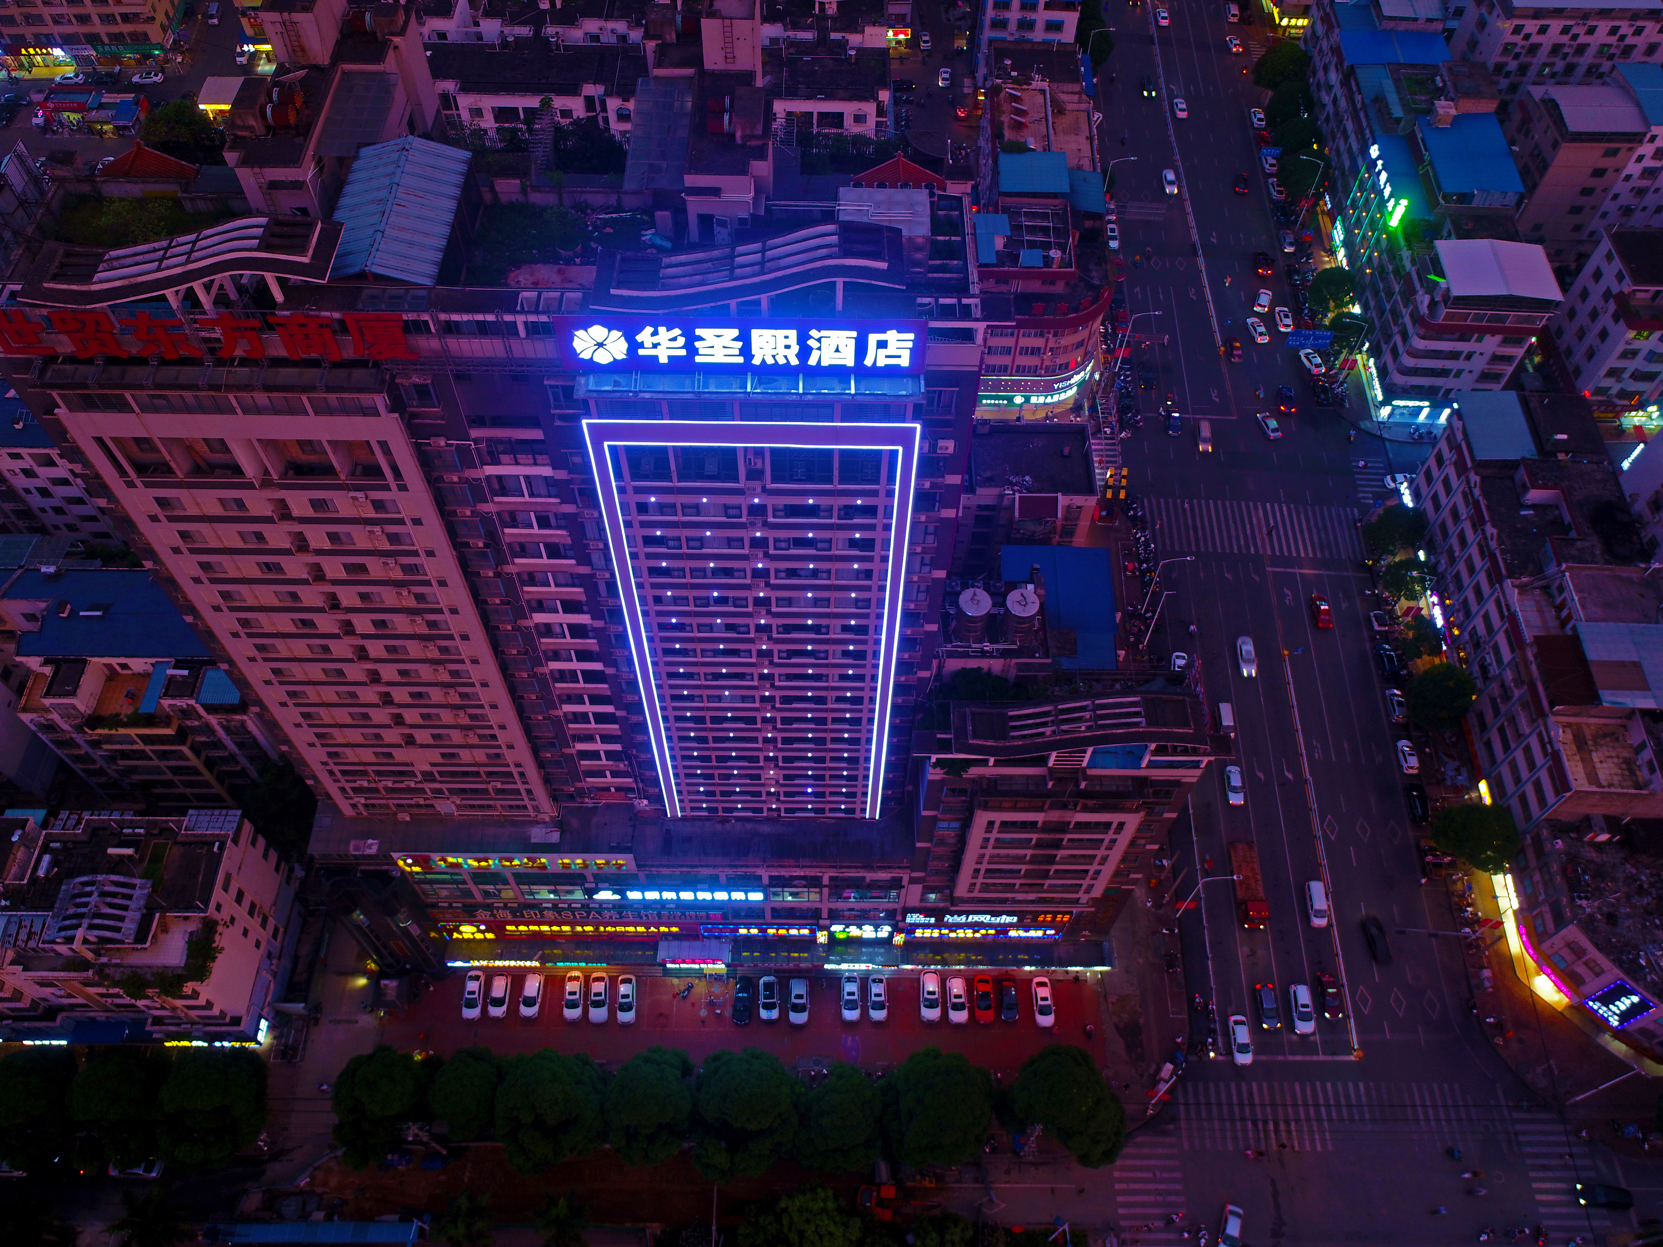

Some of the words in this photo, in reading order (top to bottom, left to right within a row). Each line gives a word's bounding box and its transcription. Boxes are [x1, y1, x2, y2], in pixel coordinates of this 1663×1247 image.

[0, 309, 419, 361] 世贸东方商厦
[635, 325, 916, 367] 华圣熙酒店
